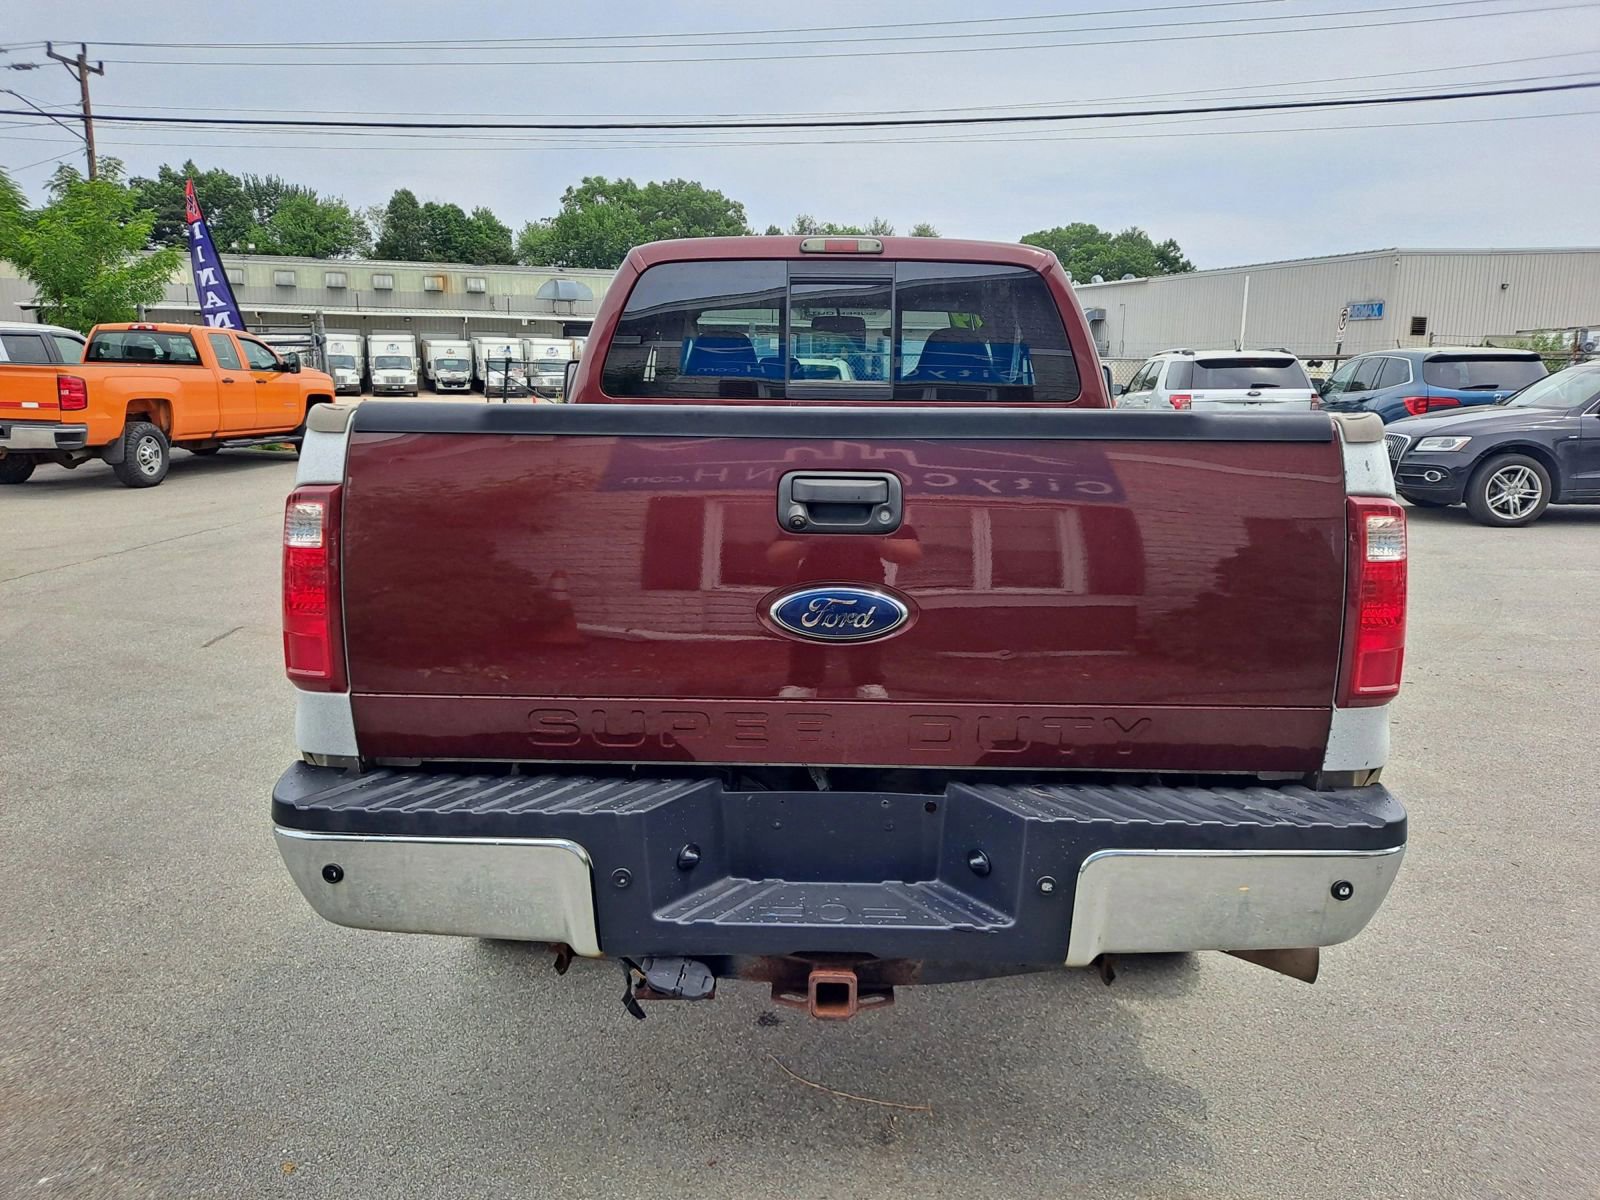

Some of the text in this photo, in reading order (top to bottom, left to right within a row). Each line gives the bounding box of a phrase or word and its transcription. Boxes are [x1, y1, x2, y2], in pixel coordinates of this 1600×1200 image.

[801, 597, 877, 628] Ford
[527, 708, 1152, 755] SUPER DUTY
